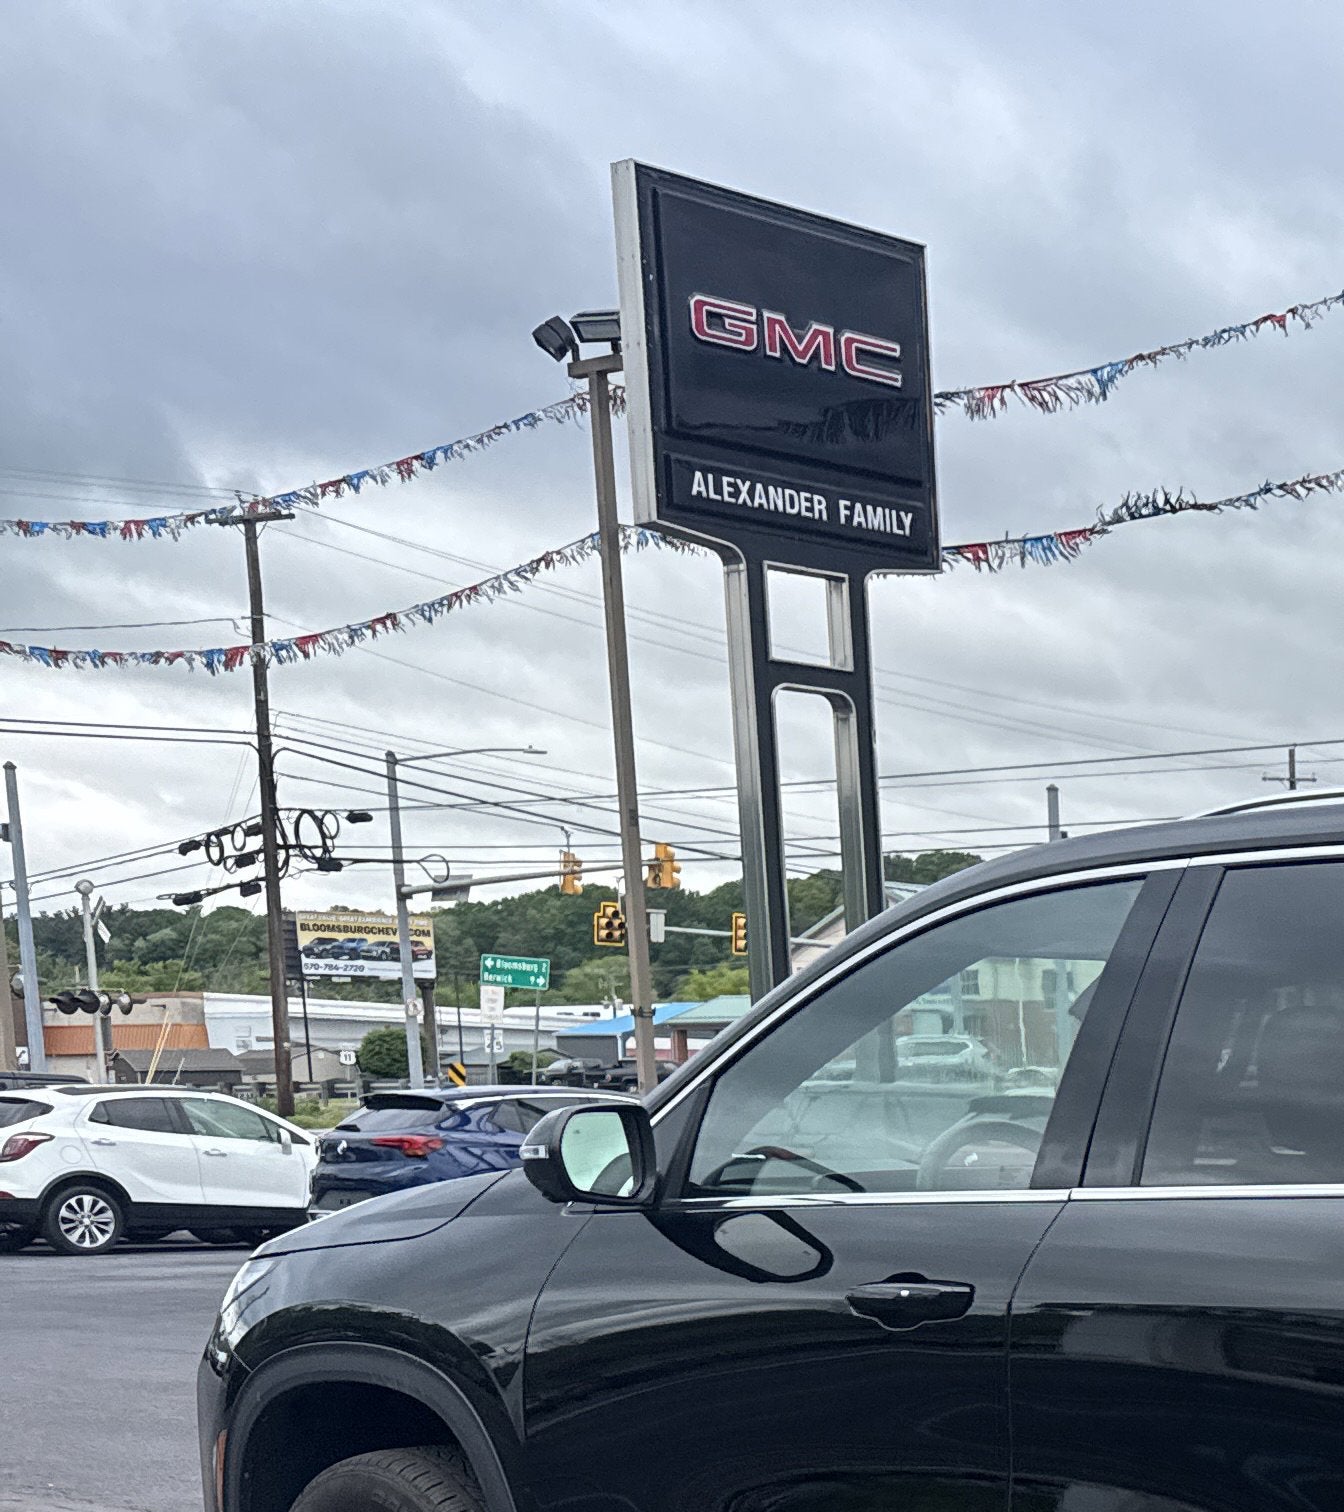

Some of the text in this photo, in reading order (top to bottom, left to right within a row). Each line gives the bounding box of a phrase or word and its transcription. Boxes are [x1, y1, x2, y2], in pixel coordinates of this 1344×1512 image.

[690, 293, 901, 388] GMC
[691, 470, 913, 537] ALEXANDER FAMILY
[496, 959, 538, 974] Bloomsburg
